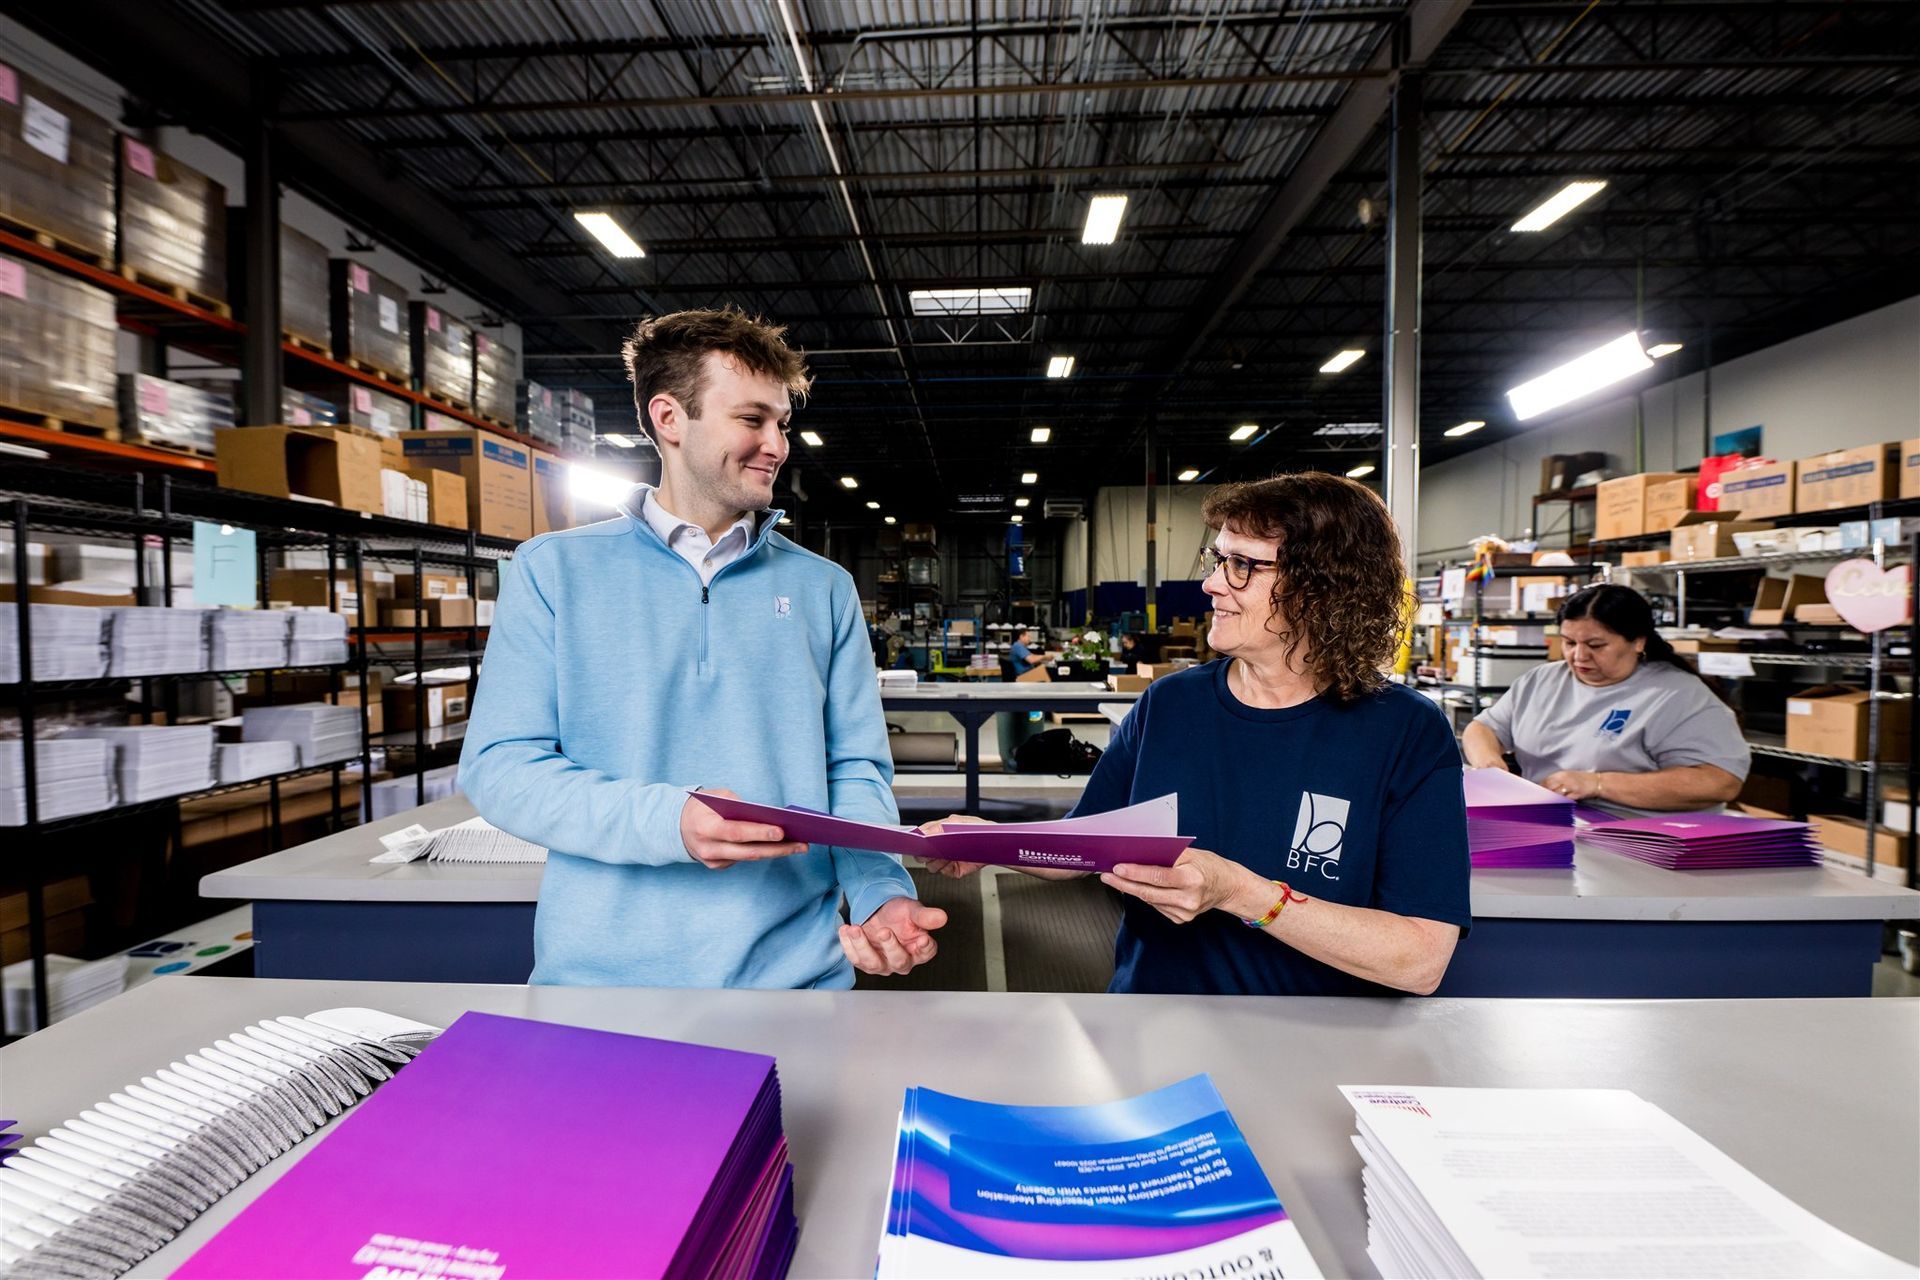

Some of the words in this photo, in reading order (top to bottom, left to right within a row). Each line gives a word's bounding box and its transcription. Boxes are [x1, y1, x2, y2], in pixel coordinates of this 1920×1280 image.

[1193, 1163, 1211, 1174] the
[1212, 1157, 1227, 1168] for
[1140, 1170, 1192, 1190] Treatment
[1194, 1167, 1232, 1186] Setting
[1015, 1183, 1056, 1196] Obesity
[1057, 1186, 1082, 1196] With
[1083, 1184, 1126, 1195] Patients
[1127, 1179, 1195, 1201] Expectations
[1128, 1182, 1139, 1192] of
[976, 1189, 1035, 1205] Medication
[1036, 1194, 1094, 1207] Prescribing
[1095, 1194, 1127, 1205] When
[1258, 1247, 1273, 1262] &
